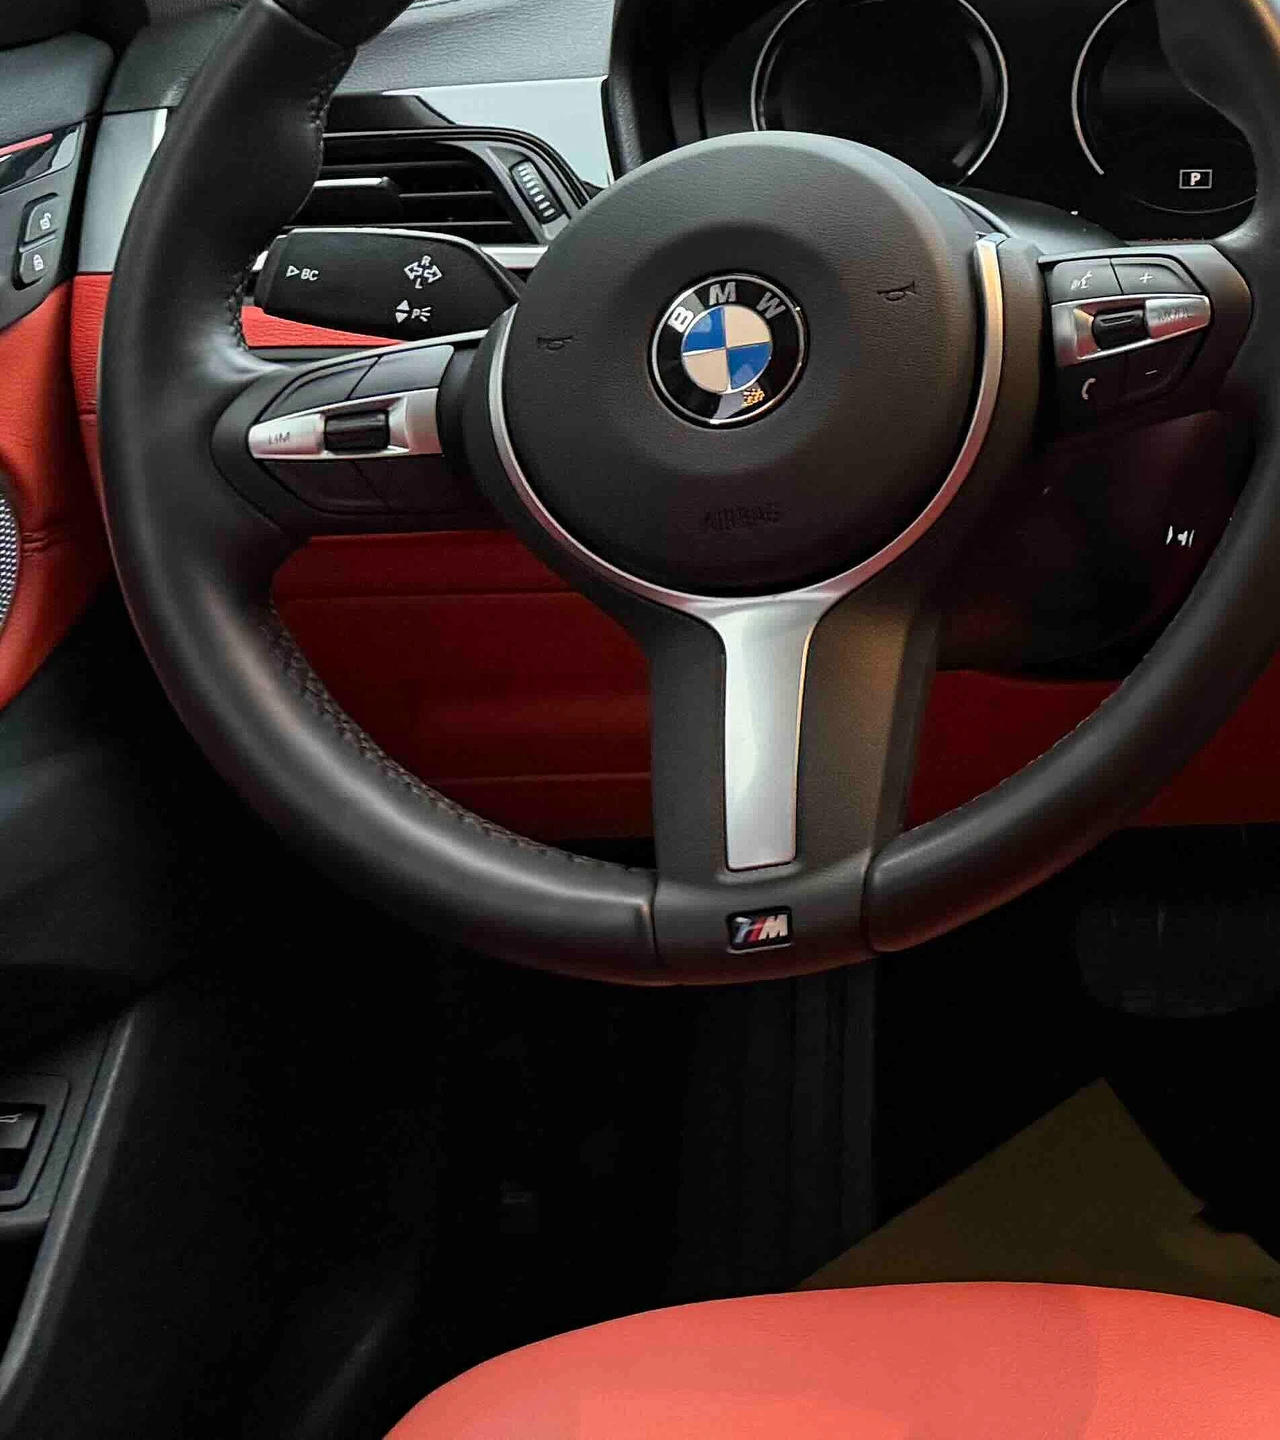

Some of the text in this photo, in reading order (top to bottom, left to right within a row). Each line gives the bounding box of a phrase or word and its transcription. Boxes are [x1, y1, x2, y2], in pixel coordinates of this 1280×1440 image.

[1190, 172, 1201, 186] P
[421, 255, 432, 266] R
[300, 267, 320, 281] BC
[414, 277, 424, 289] L
[666, 281, 787, 334] BMW
